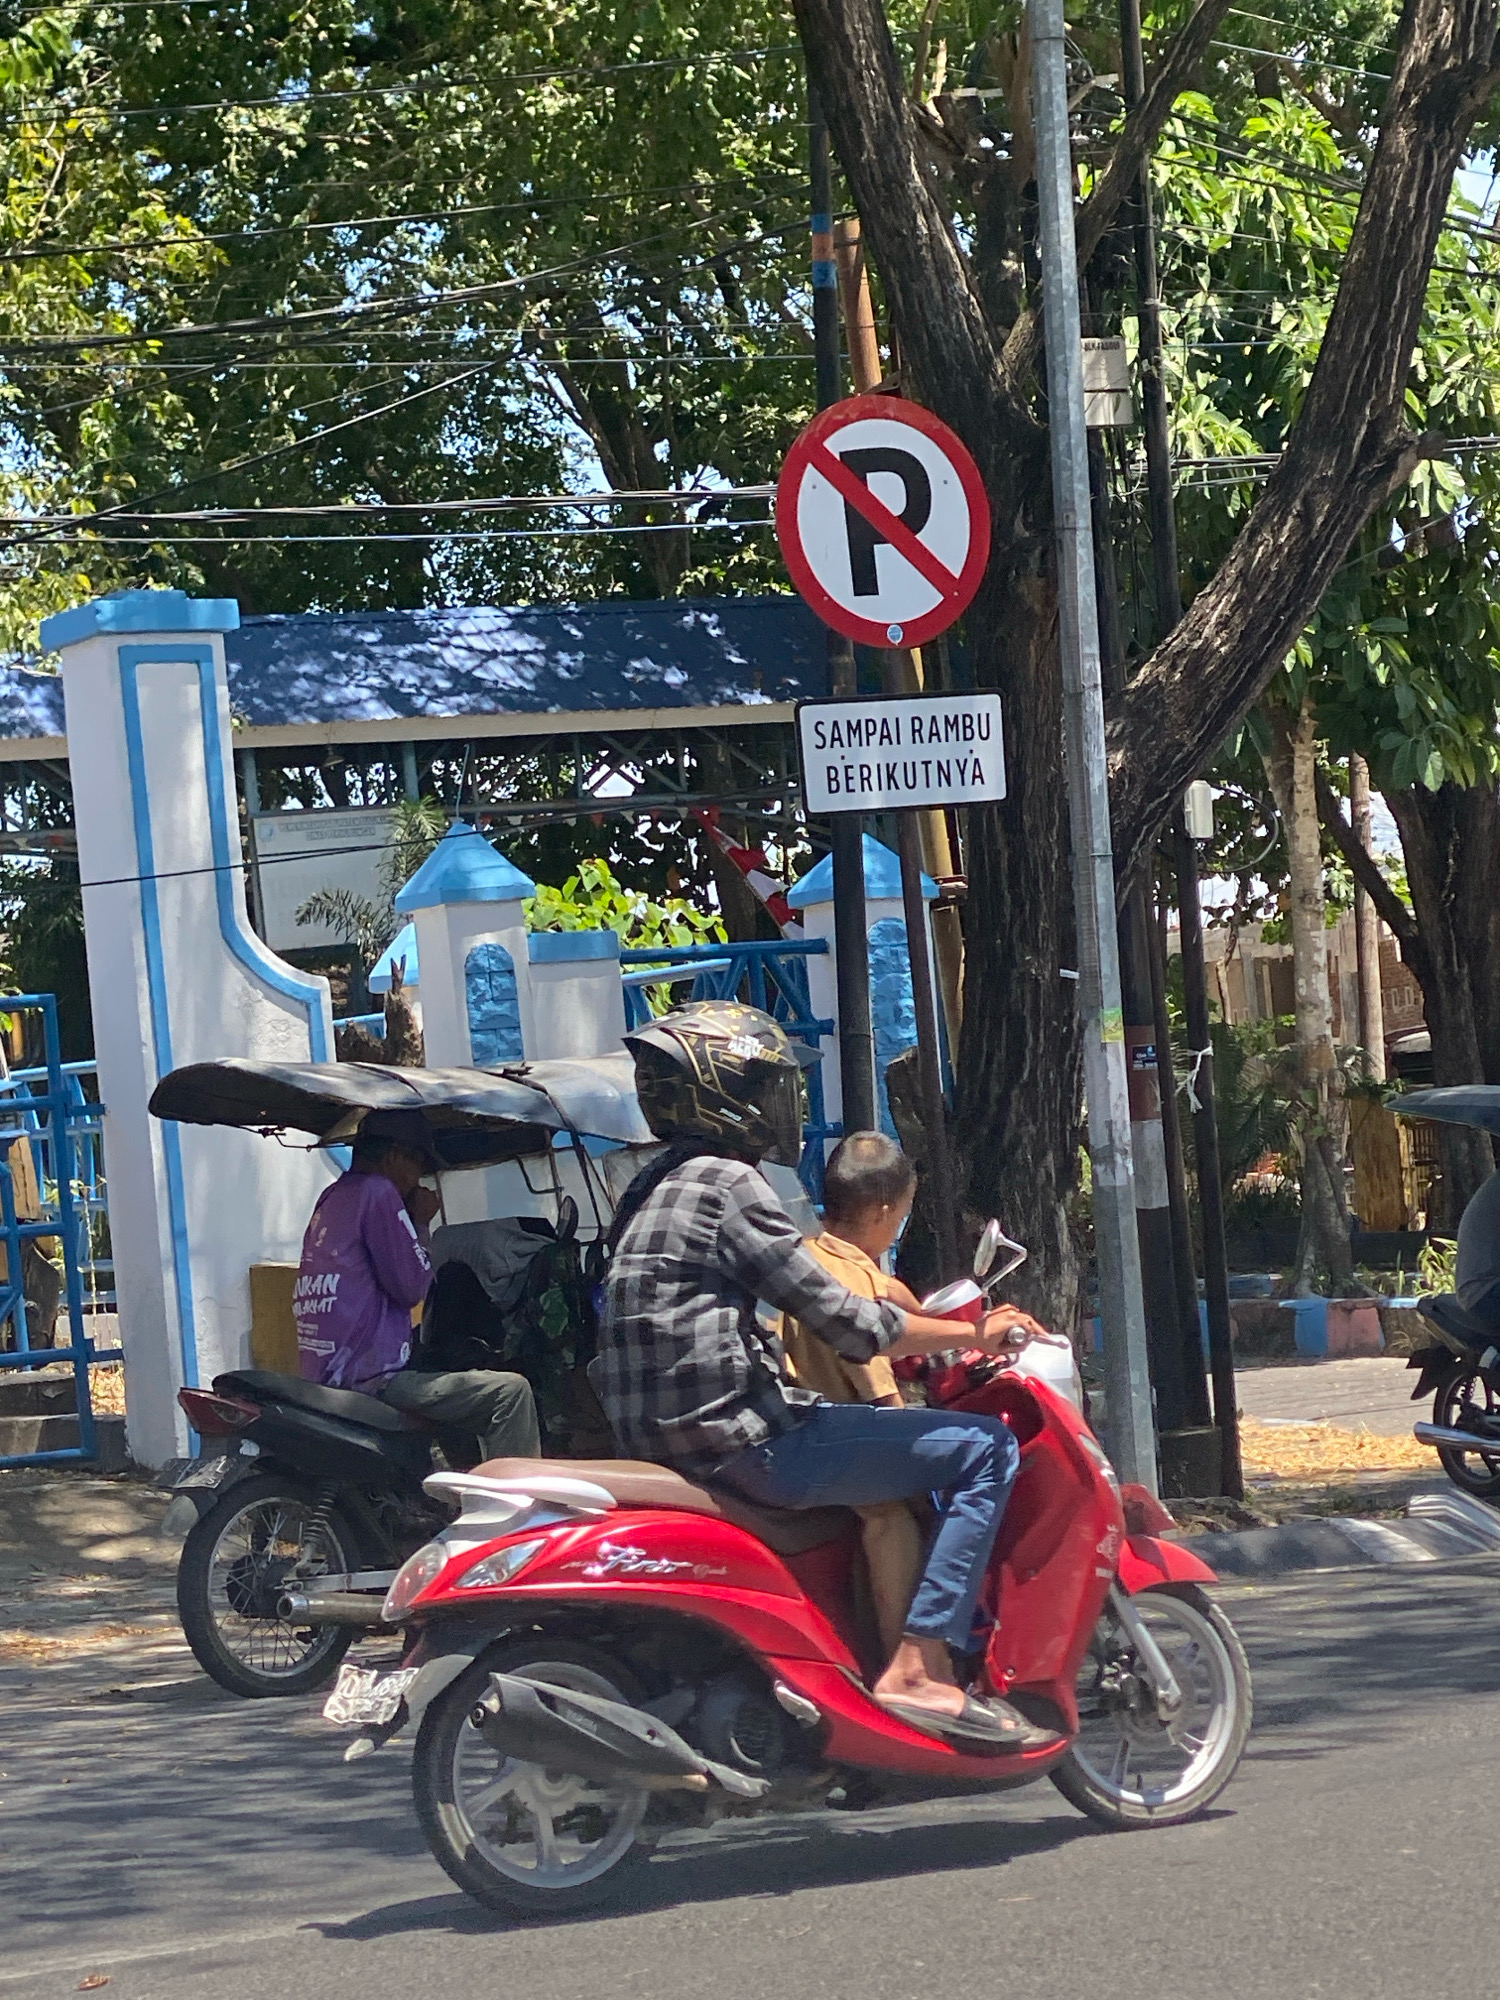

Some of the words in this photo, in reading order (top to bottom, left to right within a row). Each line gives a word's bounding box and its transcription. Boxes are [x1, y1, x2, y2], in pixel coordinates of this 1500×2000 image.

[839, 447, 932, 596] P
[814, 717, 901, 750] SAMPAI
[911, 713, 990, 744] RAMBU
[826, 757, 985, 794] BERIKUTNYA
